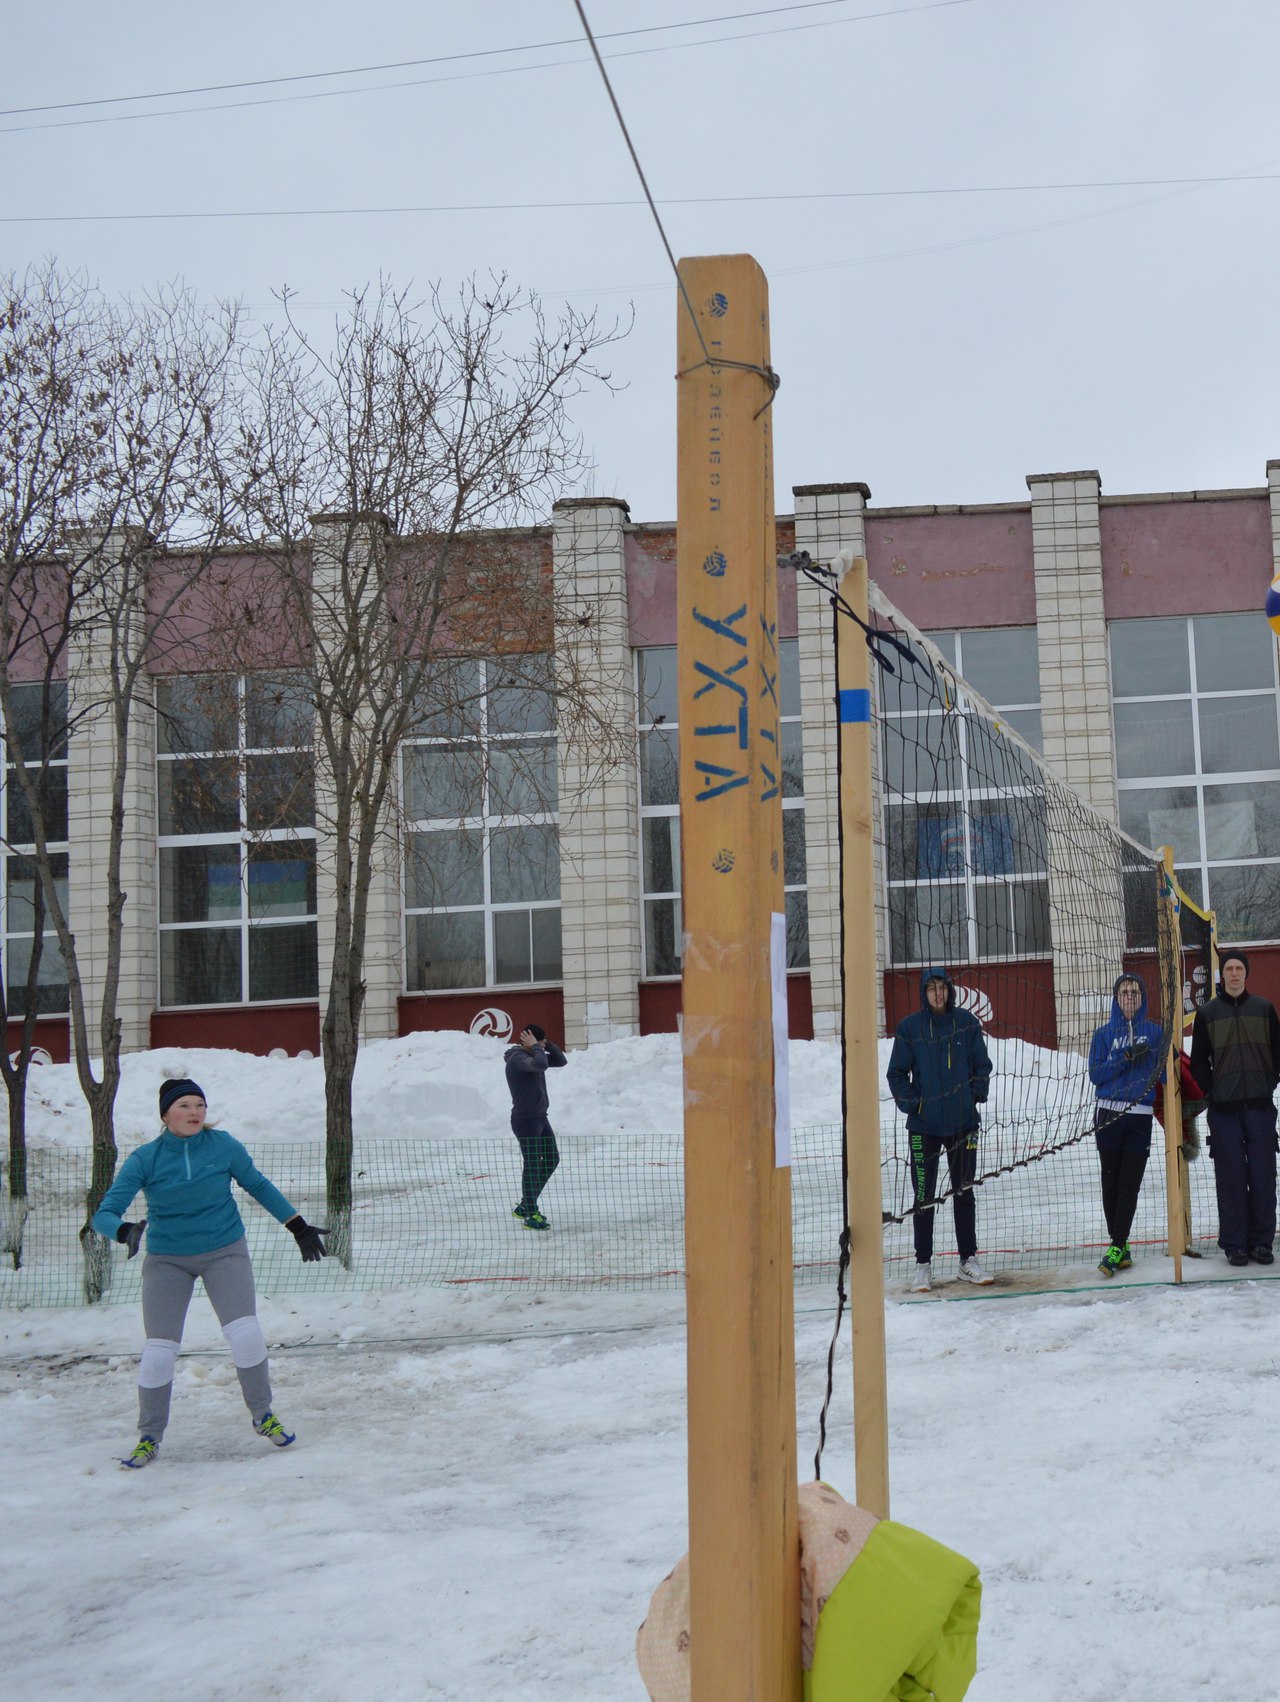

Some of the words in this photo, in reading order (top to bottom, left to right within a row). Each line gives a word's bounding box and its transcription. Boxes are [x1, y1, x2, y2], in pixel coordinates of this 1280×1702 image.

[692, 603, 750, 803] УХТА
[759, 613, 780, 803] УХТА
[911, 1135, 923, 1150] RIO
